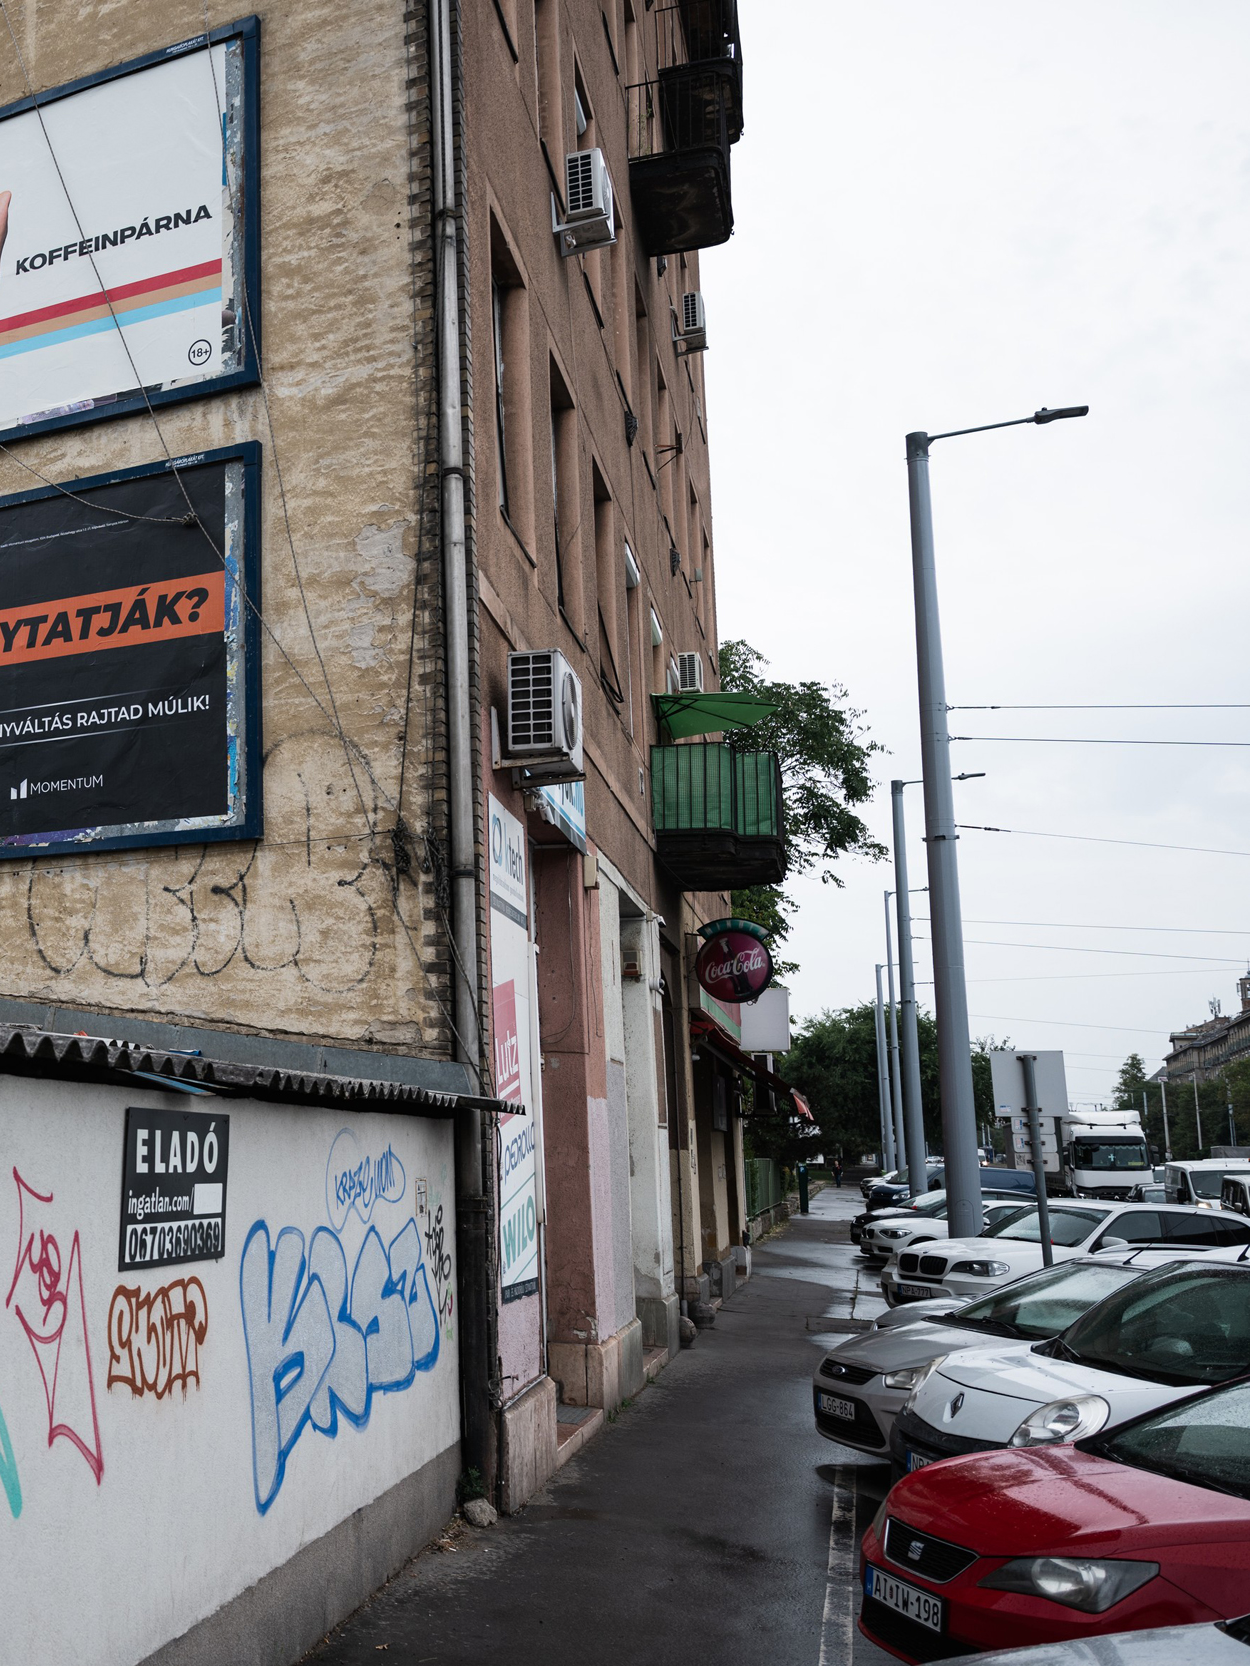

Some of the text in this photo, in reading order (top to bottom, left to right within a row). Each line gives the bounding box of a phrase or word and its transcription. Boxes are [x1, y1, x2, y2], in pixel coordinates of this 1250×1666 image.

[15, 204, 213, 275] KOFFEINPÁRNA
[190, 347, 210, 359] 18+
[77, 704, 143, 728] RAJTAD
[148, 694, 210, 718] MÚLIK!
[30, 774, 104, 796] MOMENTUM
[705, 947, 766, 984] Coca-Cola
[135, 1121, 219, 1174] ELADÓ
[502, 1195, 536, 1270] WILO
[821, 1395, 853, 1418] LGG-864
